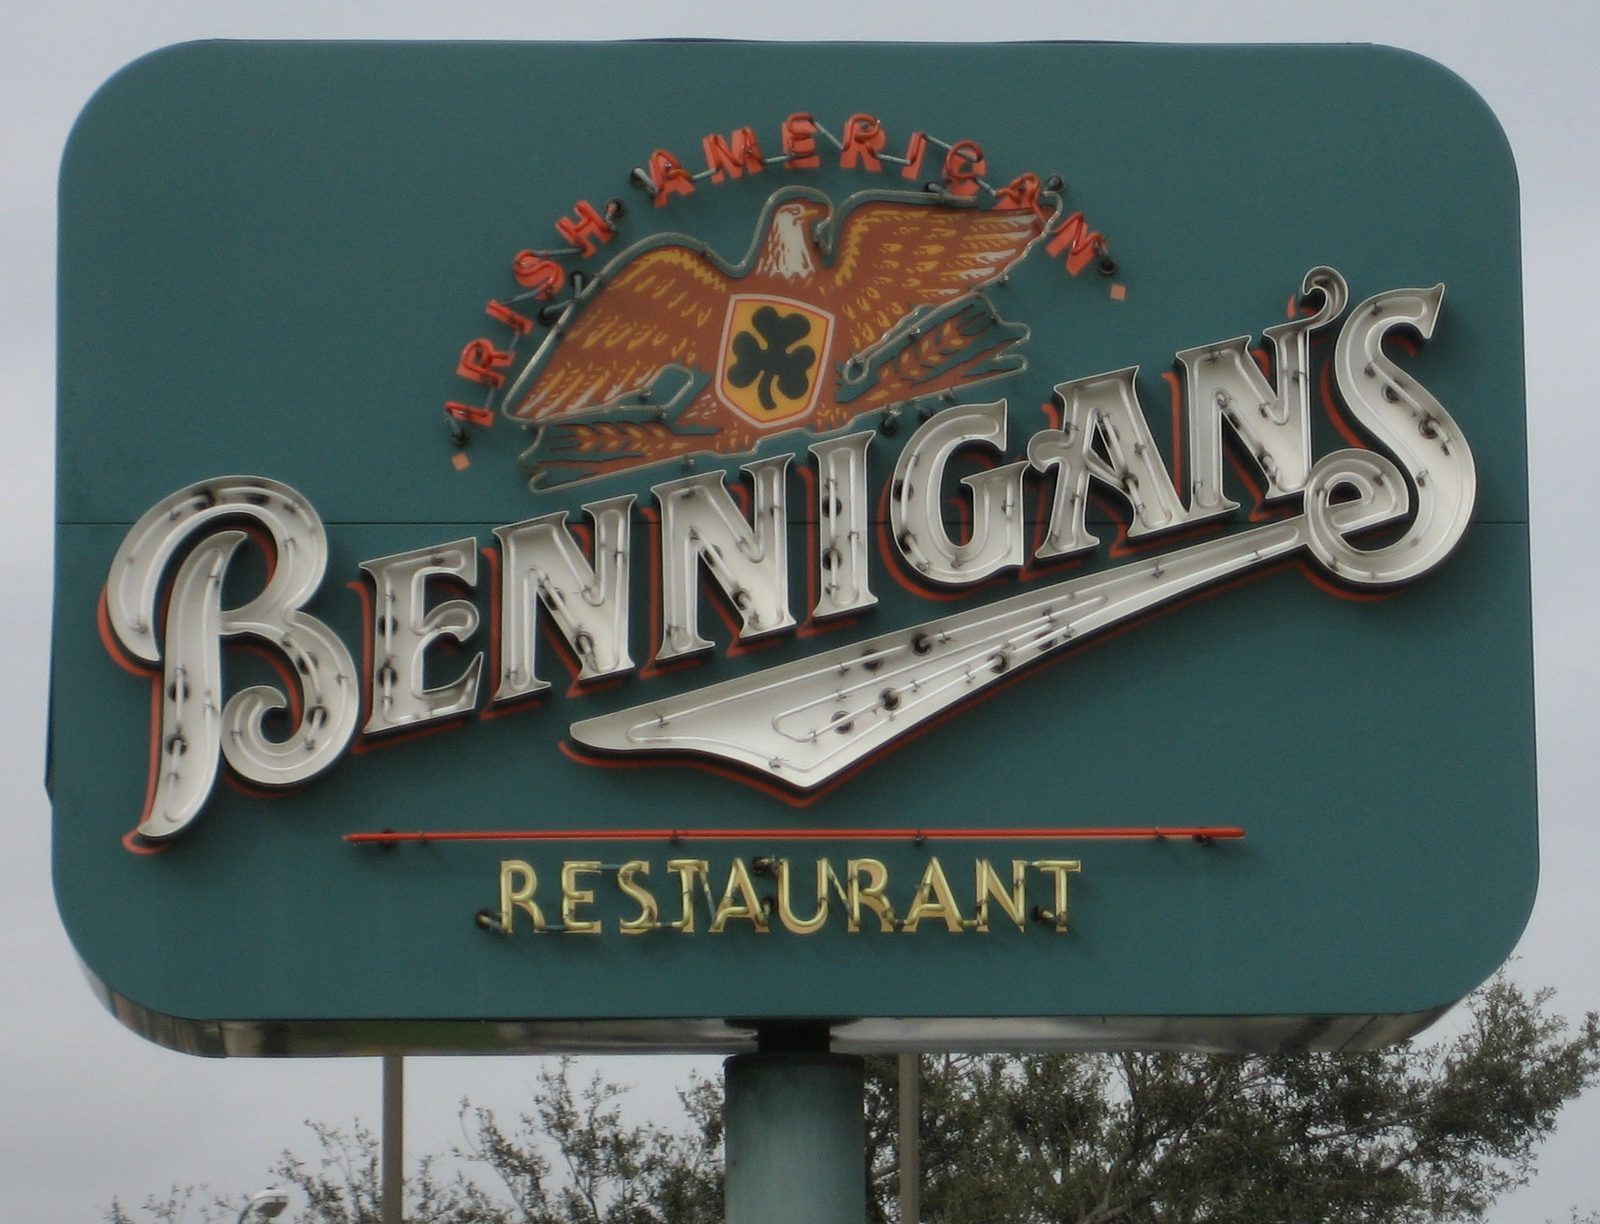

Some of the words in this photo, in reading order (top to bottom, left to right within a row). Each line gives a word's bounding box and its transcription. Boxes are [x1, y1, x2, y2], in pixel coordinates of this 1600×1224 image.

[446, 199, 616, 427] IRISH
[645, 112, 1107, 276] AMERICAN
[104, 265, 1478, 843] BENNIGAN'S
[499, 856, 1083, 935] RESTAURANT
